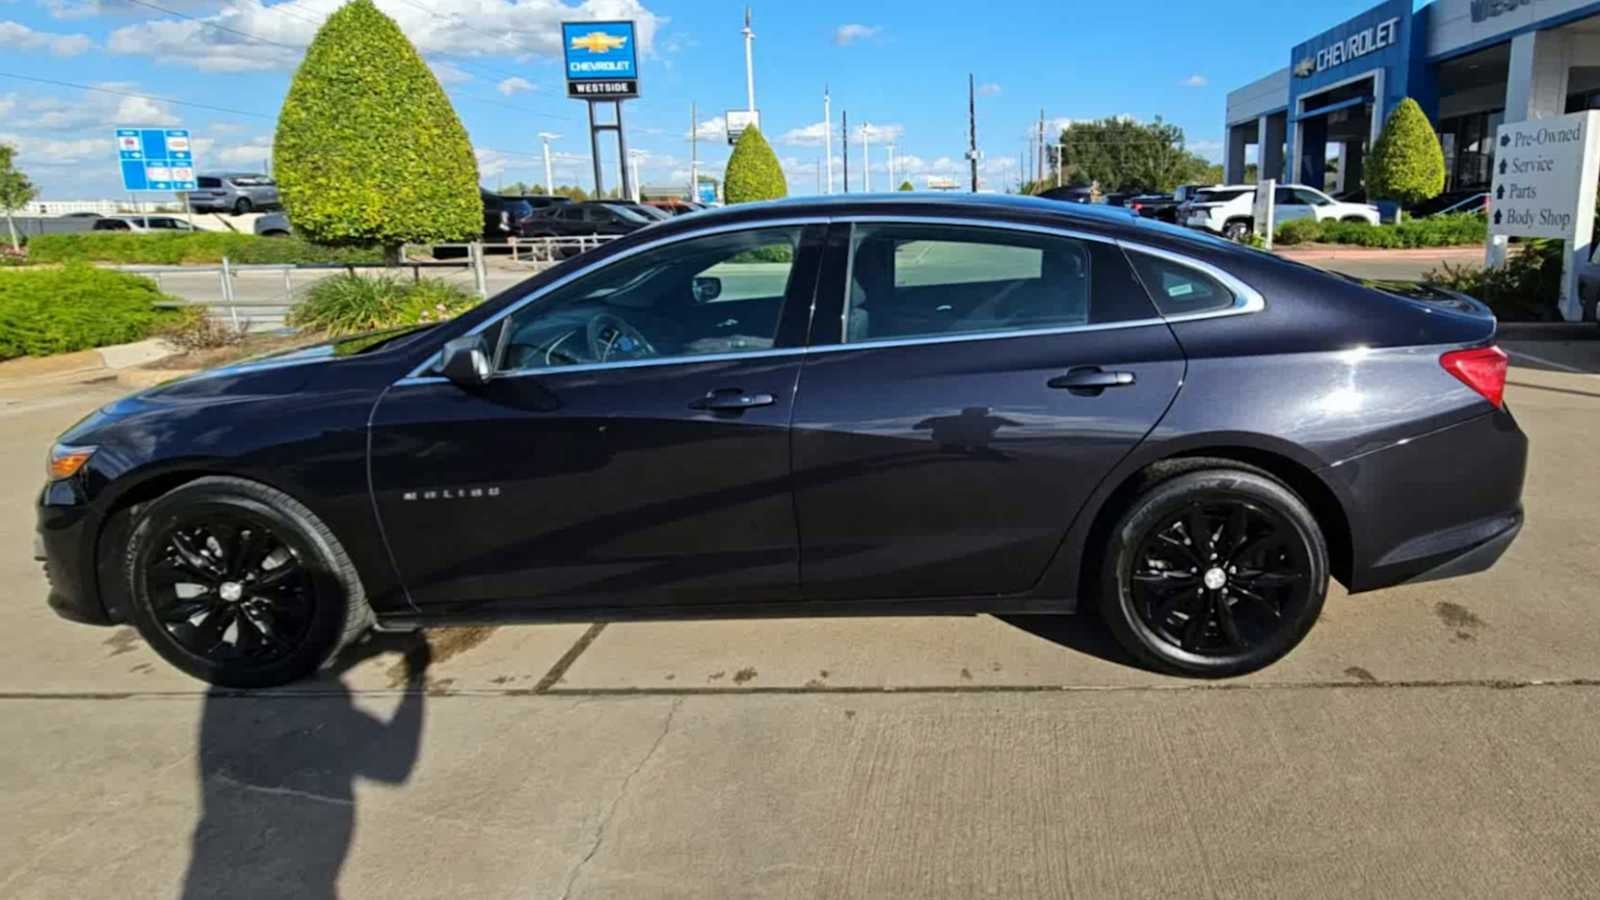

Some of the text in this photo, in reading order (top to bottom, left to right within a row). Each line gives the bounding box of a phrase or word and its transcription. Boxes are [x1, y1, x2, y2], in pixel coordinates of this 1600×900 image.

[1316, 17, 1400, 72] CHEVROLET
[575, 82, 629, 93] WESTSIDE
[1514, 122, 1582, 147] Pre-Owned
[1512, 154, 1554, 174] Service
[1509, 183, 1537, 199] Parts
[1507, 207, 1571, 231] Body Shop
